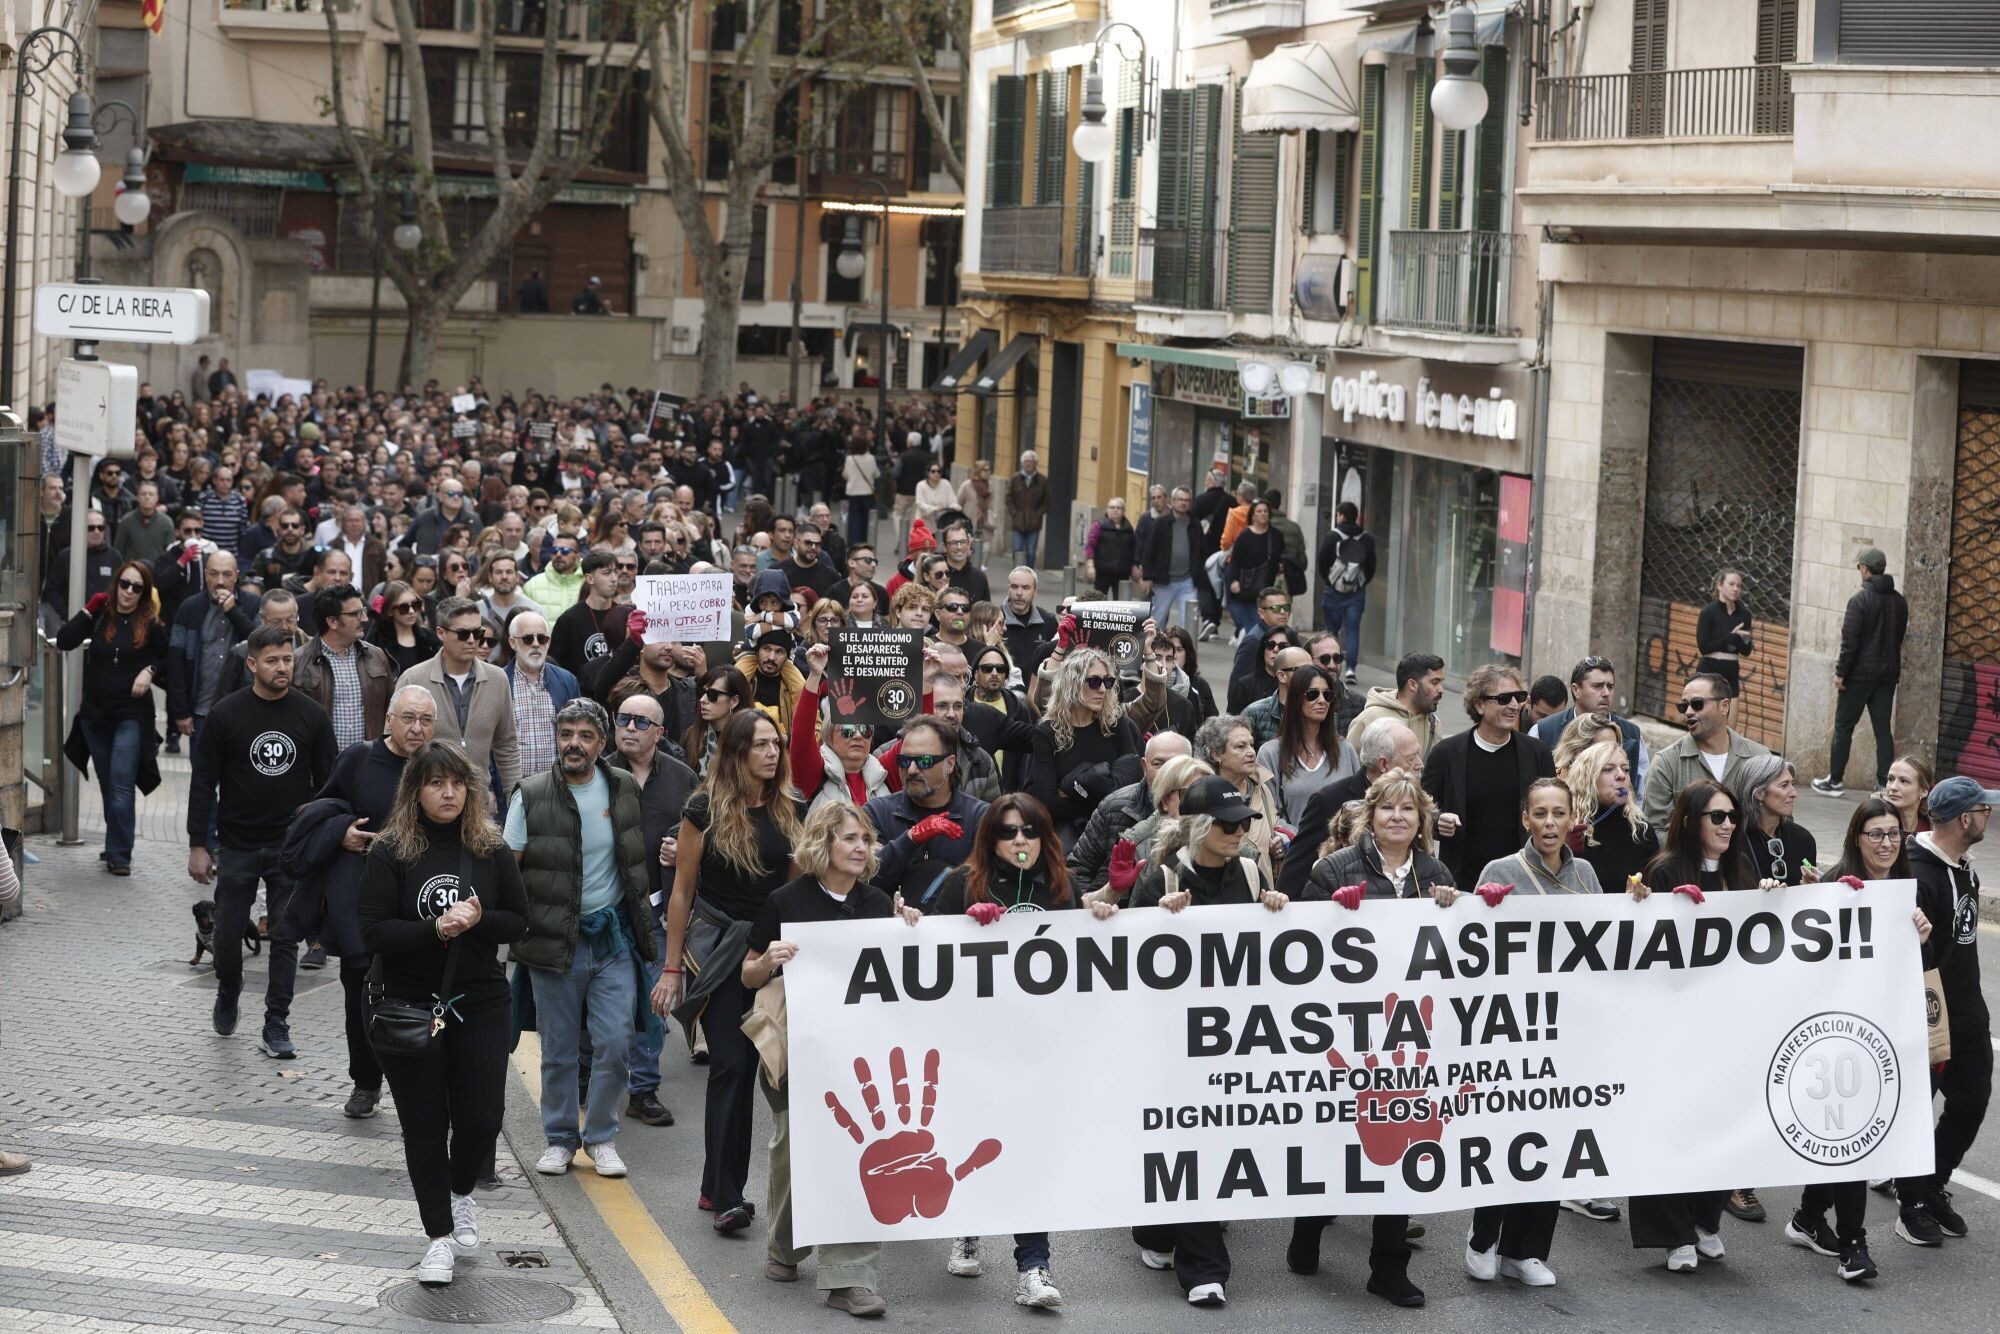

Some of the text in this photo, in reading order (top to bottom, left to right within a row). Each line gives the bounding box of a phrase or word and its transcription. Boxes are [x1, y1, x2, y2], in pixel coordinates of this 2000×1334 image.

[58, 294, 173, 318] C/ DE LA RIERA
[646, 579, 722, 596] TRABAJO PARA
[669, 600, 697, 612] PERO
[700, 598, 726, 610] COBRO
[645, 617, 669, 629] PARA
[1082, 611, 1137, 624] EL PAÍS ENTERO
[1083, 620, 1134, 633] SE DESVANECE
[839, 631, 912, 643] SI EL AUTÓNOMO
[594, 641, 608, 653] 30
[846, 644, 904, 656] DESAPARECE,
[1117, 641, 1131, 653] 30
[842, 655, 909, 666] EL PAÍS ENTERO
[843, 667, 906, 677] SE DESVANECE
[887, 689, 905, 704] 30
[893, 703, 899, 711] N
[263, 742, 283, 758] 30
[269, 757, 277, 766] N
[421, 876, 455, 903] MANIFESTACIÓN
[435, 888, 459, 907] 30
[844, 906, 1873, 1005] AUTÓNOMOS ASFIXIADOS!!
[1187, 991, 1559, 1057] BASTA YA!!
[1773, 1020, 1895, 1085] MANIFESTACION NACIONAL
[1208, 1056, 1557, 1095] “PLATAFORMA PARA LA
[1804, 1051, 1862, 1100] 30
[1143, 1083, 1626, 1131] DIGNIDAD DE LOS AUTÓNOMOS”
[1824, 1103, 1845, 1131] N
[1785, 1117, 1886, 1158] DE AUTONOMOS
[1143, 1128, 1610, 1204] MALLORCA
